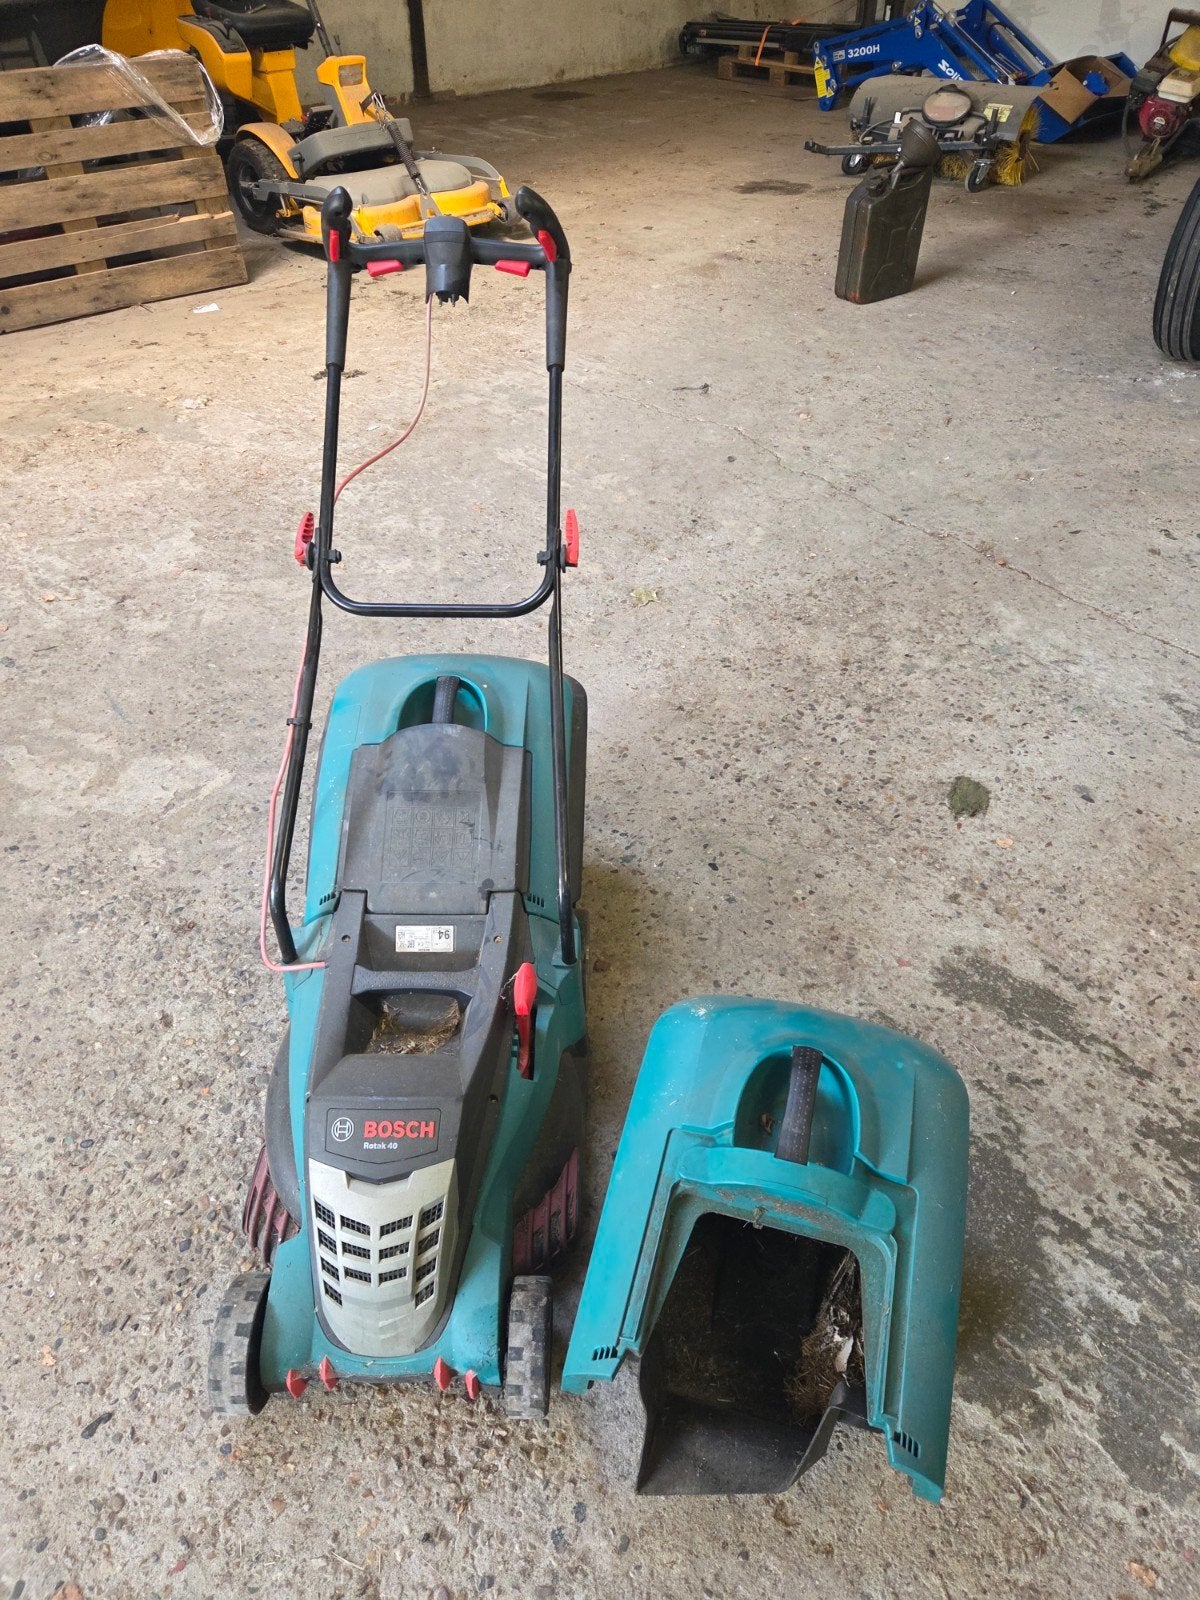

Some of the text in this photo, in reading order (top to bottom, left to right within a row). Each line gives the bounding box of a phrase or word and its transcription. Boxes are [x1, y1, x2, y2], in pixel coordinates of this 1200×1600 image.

[847, 44, 880, 58] 3200H
[438, 930, 450, 940] 94
[363, 1120, 436, 1139] BOSCH
[363, 1142, 398, 1150] Rotak 40
